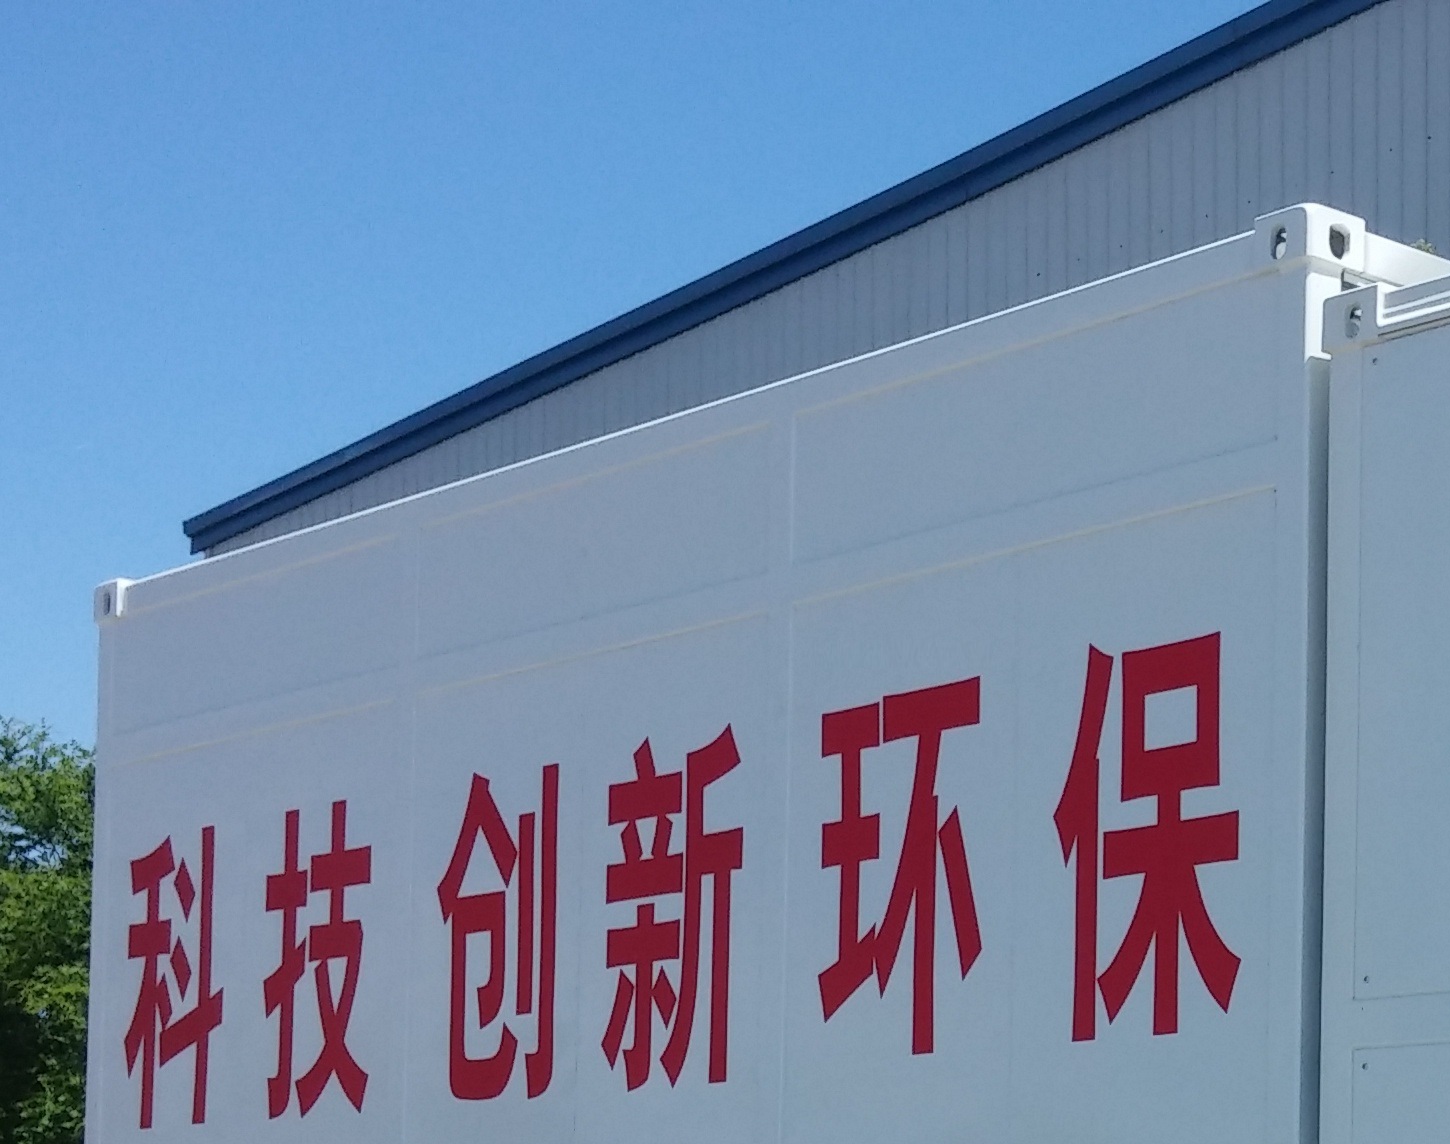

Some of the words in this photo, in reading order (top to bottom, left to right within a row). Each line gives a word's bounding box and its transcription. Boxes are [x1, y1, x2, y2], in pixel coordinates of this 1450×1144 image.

[124, 631, 1242, 1130] 科技创新环保
